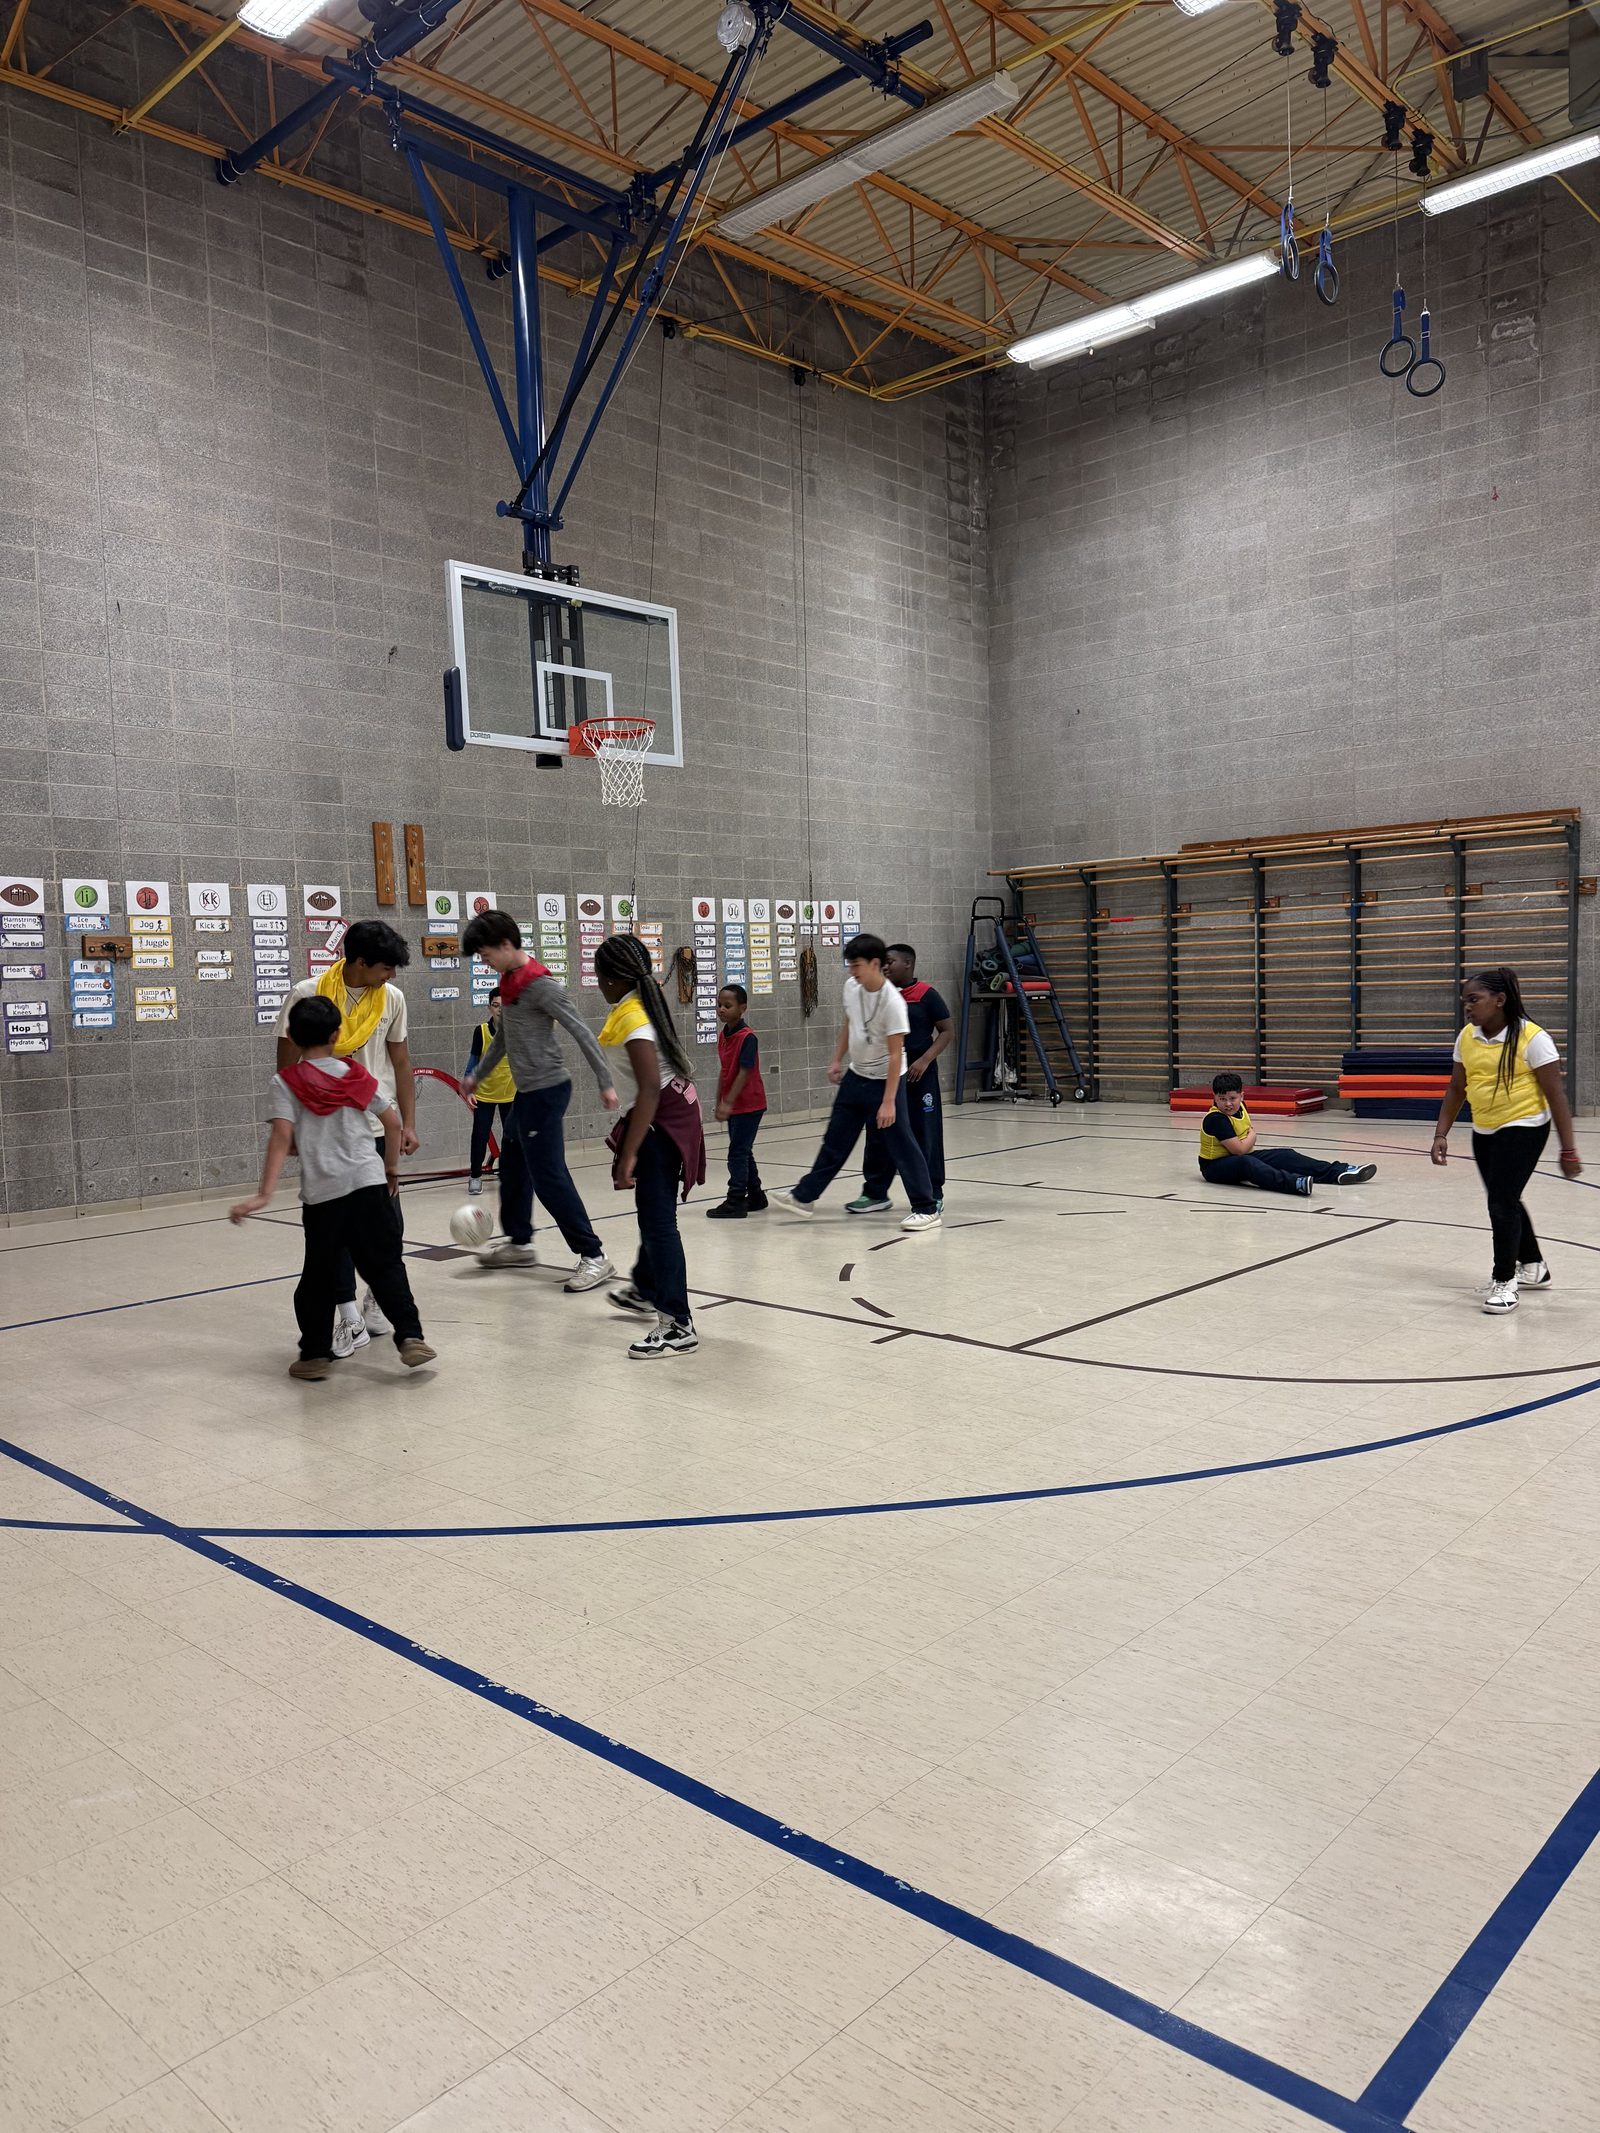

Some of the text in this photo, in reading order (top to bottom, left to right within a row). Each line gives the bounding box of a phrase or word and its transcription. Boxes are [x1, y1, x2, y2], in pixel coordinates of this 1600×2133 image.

[202, 892, 218, 905] Kk
[140, 920, 154, 930] Jog
[145, 939, 169, 948] Juggle
[259, 952, 275, 960] Leap
[137, 957, 158, 965] Jump
[200, 971, 220, 979] Kneel
[12, 1025, 31, 1033] Hop
